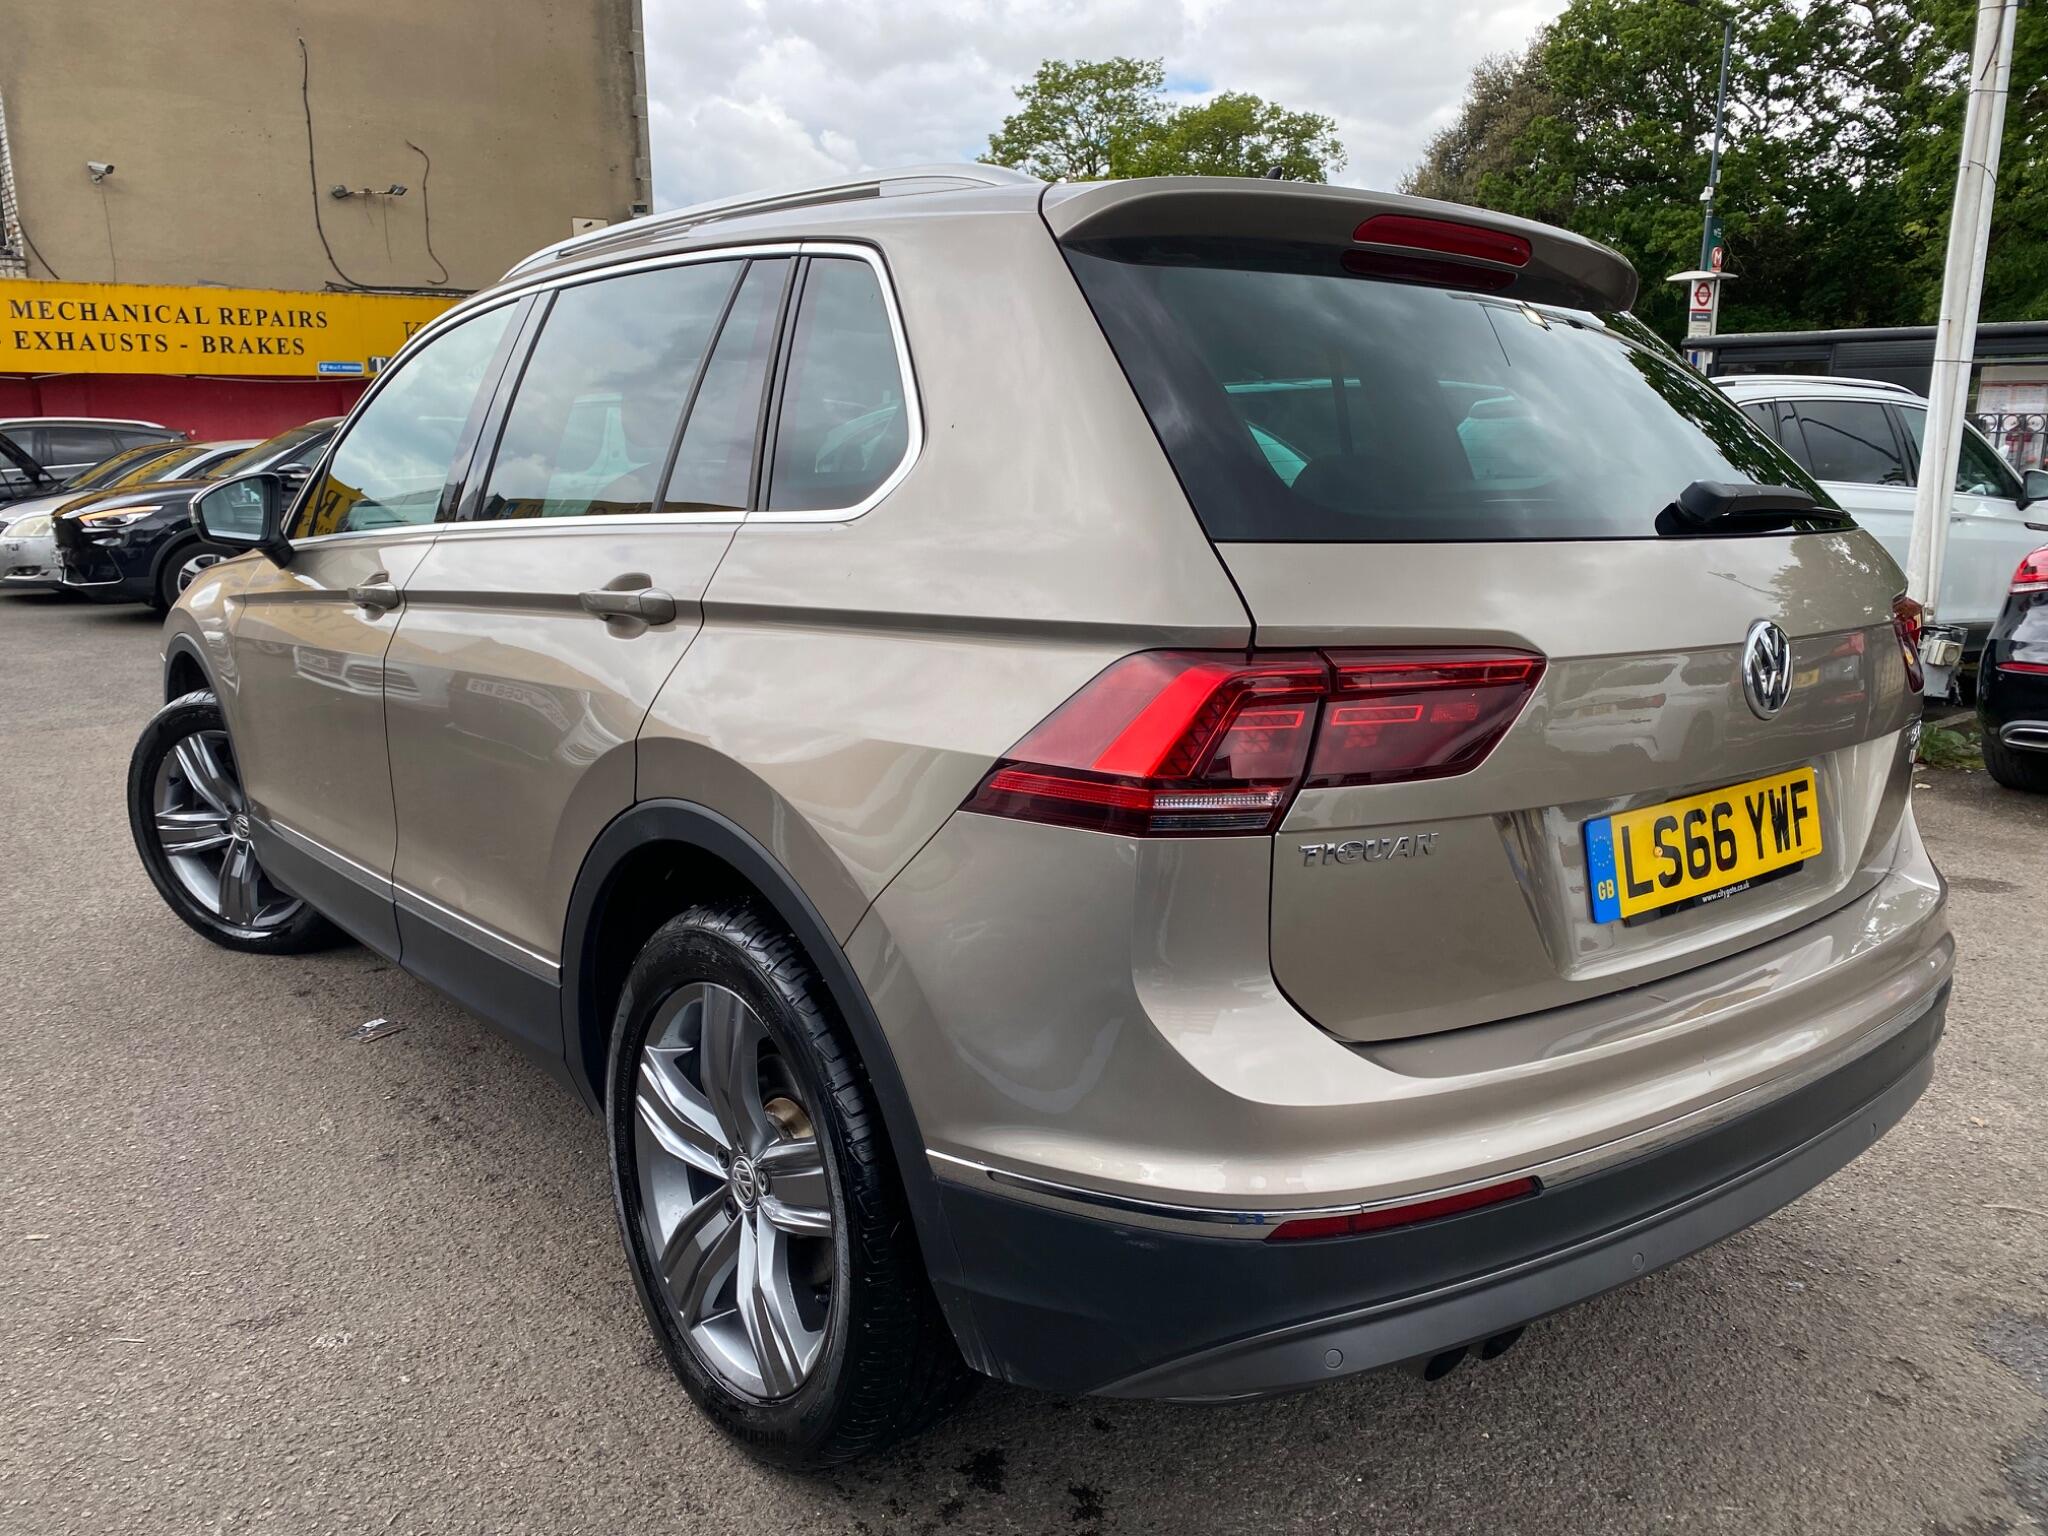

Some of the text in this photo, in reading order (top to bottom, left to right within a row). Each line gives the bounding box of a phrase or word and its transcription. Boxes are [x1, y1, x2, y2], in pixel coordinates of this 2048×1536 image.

[8, 299, 328, 329] MECHANICAL REPAIRS
[13, 330, 168, 353] EXHAUSTS
[201, 335, 306, 356] BRAKES
[1298, 832, 1440, 867] TIGUAN
[1621, 779, 1809, 899] LS66 YWF
[1597, 879, 1616, 901] GB
[1701, 880, 1750, 903] www.citygate.co.uk
